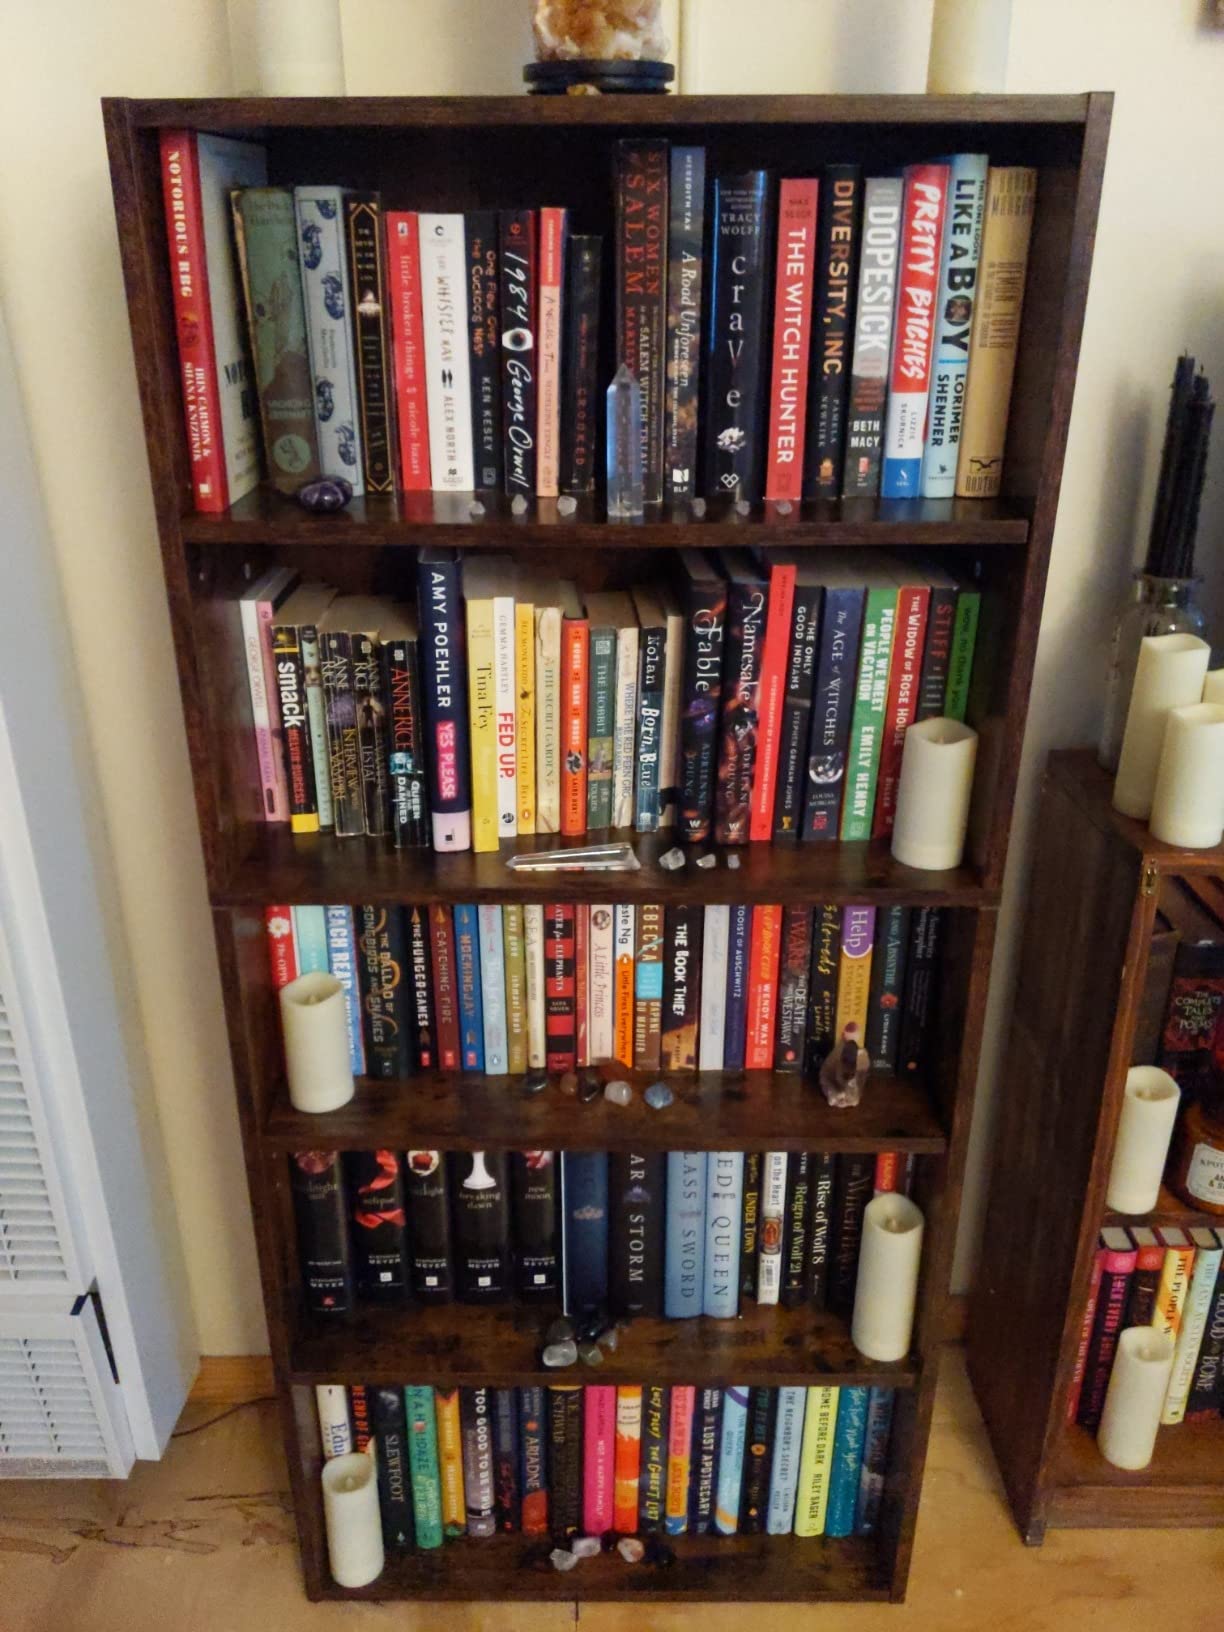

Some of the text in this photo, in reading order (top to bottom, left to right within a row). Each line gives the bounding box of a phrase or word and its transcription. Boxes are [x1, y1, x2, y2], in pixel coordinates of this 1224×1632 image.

[166, 151, 193, 297] NOTORIOUS RBG
[683, 154, 692, 230] MEREDITH TAX
[948, 178, 975, 262] LIKE A
[624, 174, 644, 294] SALEM
[646, 203, 659, 294] WOMEN
[504, 252, 529, 321] 1984
[856, 204, 898, 354] DOPESICK
[897, 182, 942, 381] PRETTY BITCHES
[398, 255, 418, 379] little broken things
[674, 267, 696, 386] Road Unforeseen
[776, 226, 805, 463] THE WITCH HUNTER
[183, 361, 196, 399] SHANA
[194, 367, 211, 449] IRIN CARMON
[638, 327, 648, 421] SALEM WITCH
[947, 373, 965, 444] LORIMER
[480, 375, 492, 451] KEN KESEY
[505, 359, 532, 487] George Orwell
[850, 436, 880, 448] MACY
[853, 420, 880, 432] BETH
[930, 373, 949, 447] SHENHER
[431, 571, 450, 708] AMY POEHLER
[644, 634, 661, 684] Nolan
[688, 608, 724, 692] Fable
[737, 591, 764, 701] Namesake
[789, 605, 806, 690] GOOD INDIANS
[802, 620, 815, 674] THE ONLY
[829, 629, 844, 662] AGE
[857, 639, 876, 702] VACATION
[870, 607, 893, 712] PEOPLE WE MEET
[897, 595, 921, 704] THE WIDOW ROSE
[276, 660, 305, 728] smack
[390, 667, 411, 716] ANNE
[476, 662, 493, 700] Tina
[595, 662, 606, 735] THE HOBBIT
[497, 711, 514, 746] FED
[544, 667, 553, 777] THE SECRET GARDEN
[621, 681, 635, 777] WHERE THE RED FERN
[438, 722, 456, 799] YES PLEASE
[786, 748, 797, 782] GRAHAM
[851, 725, 875, 817] EMILY HENRY
[394, 775, 409, 824] DAMNED
[409, 780, 422, 819] QUEEN
[618, 927, 630, 944] Ng
[845, 908, 868, 949] Help
[883, 936, 900, 986] ABSINTHE
[362, 905, 383, 1042] SONGBIRDS SNAKES
[379, 951, 393, 999] BALLAD
[411, 939, 429, 1026] HUNGER GAMES
[435, 930, 452, 1023] CATCHING FIRE
[554, 944, 564, 991] ELEPHANTS
[592, 954, 609, 1018] Little Princess
[672, 923, 688, 1016] THE BOOK THIEF
[731, 949, 743, 997] AUSCHWITZ
[618, 970, 628, 1058] Little Fires Everywhere
[759, 982, 771, 1045] WENDY WAX
[779, 994, 794, 1045] WESTAWAY
[792, 987, 806, 1024] DEATH
[744, 1191, 758, 1225] UNDER
[790, 1185, 807, 1219] Reign
[792, 1221, 804, 1233] of
[811, 1180, 831, 1264] Rise of Wolf 8
[629, 1214, 644, 1282] STORM
[679, 1228, 696, 1298] SWORD
[709, 1215, 731, 1296] QUEEN
[742, 1225, 756, 1253] TOWN
[790, 1236, 803, 1260] Wolf
[1173, 1256, 1188, 1278] THE
[785, 1390, 795, 1405] THE
[1197, 1354, 1220, 1392] BONE
[475, 1388, 491, 1516] TOO GOOD TO BE TRUE
[813, 1386, 831, 1465] HOME BEFORE DARK
[384, 1433, 404, 1503] SLEWFOOT
[526, 1436, 539, 1488] ARIADNE
[697, 1425, 716, 1515] LOST APOTHECARY
[779, 1453, 790, 1480] SECRET
[807, 1472, 822, 1519] RILEY SAGER
